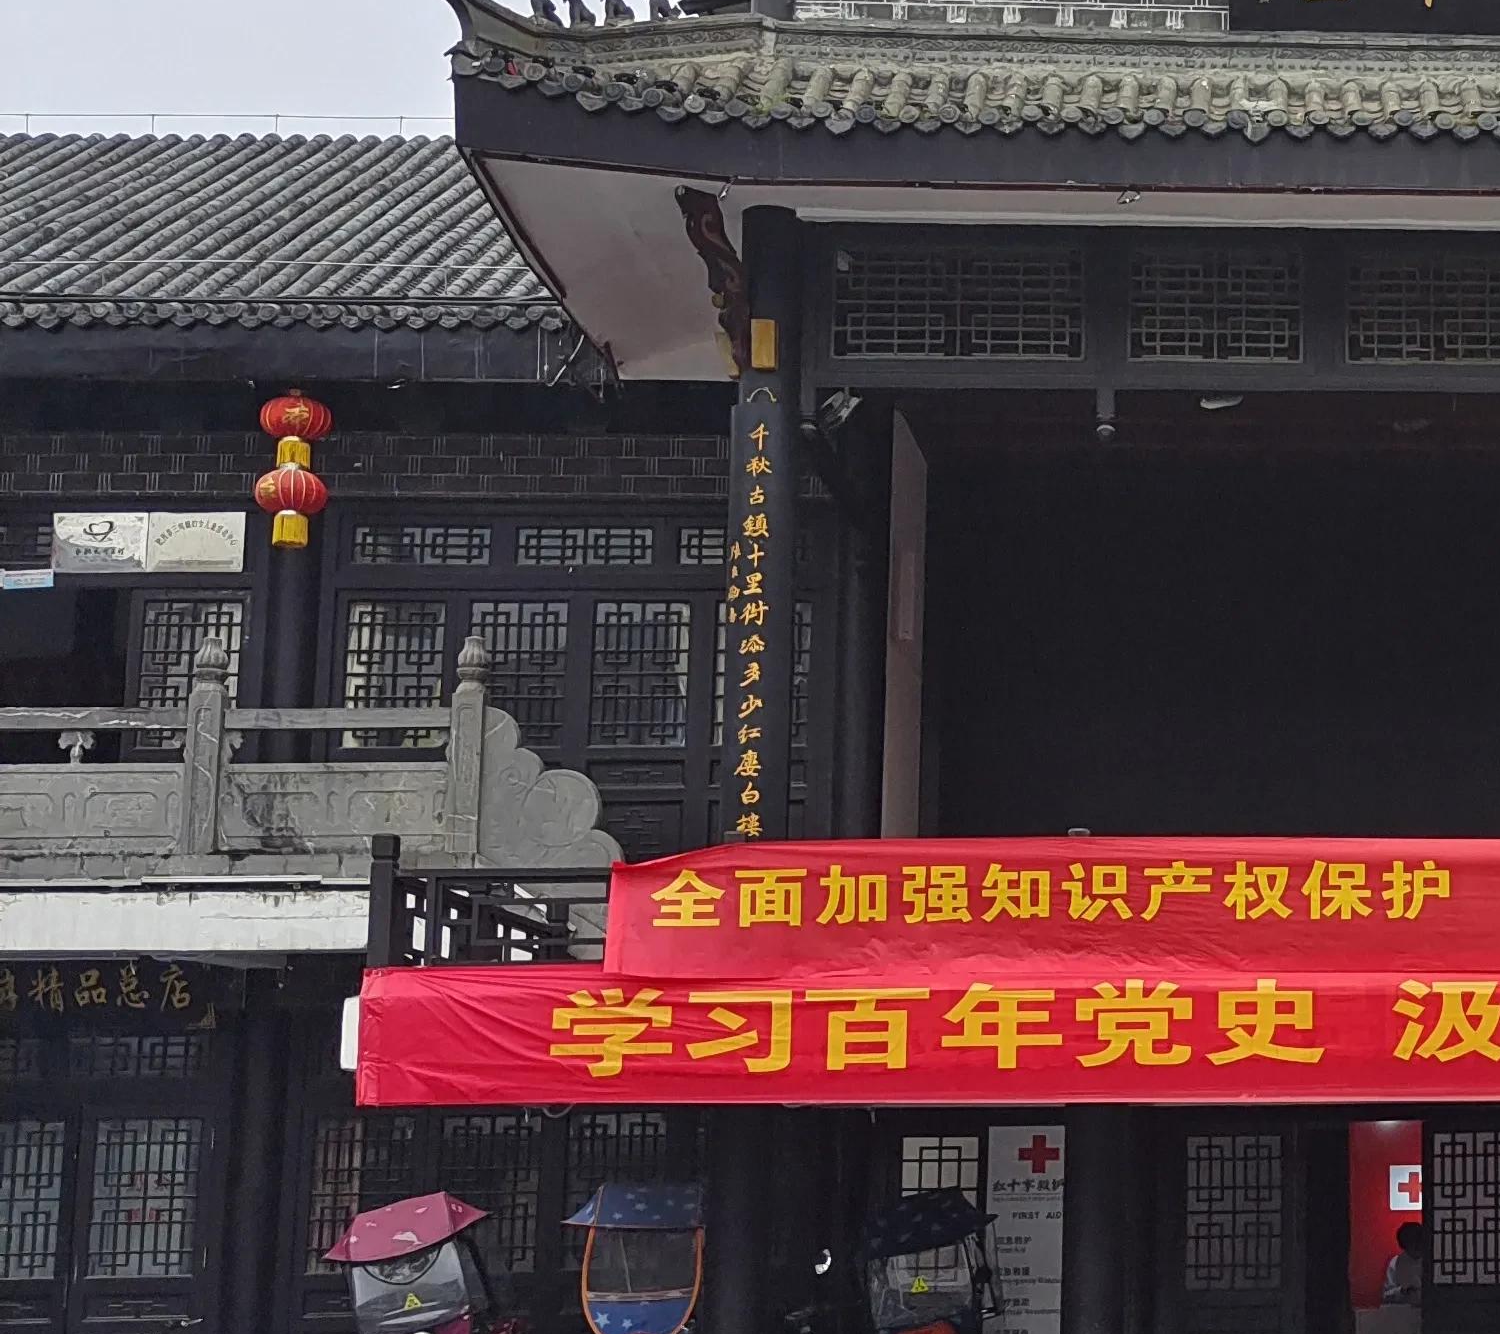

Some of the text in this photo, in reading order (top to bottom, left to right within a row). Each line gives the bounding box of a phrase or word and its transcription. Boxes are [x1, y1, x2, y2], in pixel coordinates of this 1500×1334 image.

[650, 859, 1452, 929] 全面加强知识产权保护
[550, 977, 1325, 1078] 学习百年党史
[1012, 1211, 1062, 1220] FIRST AID
